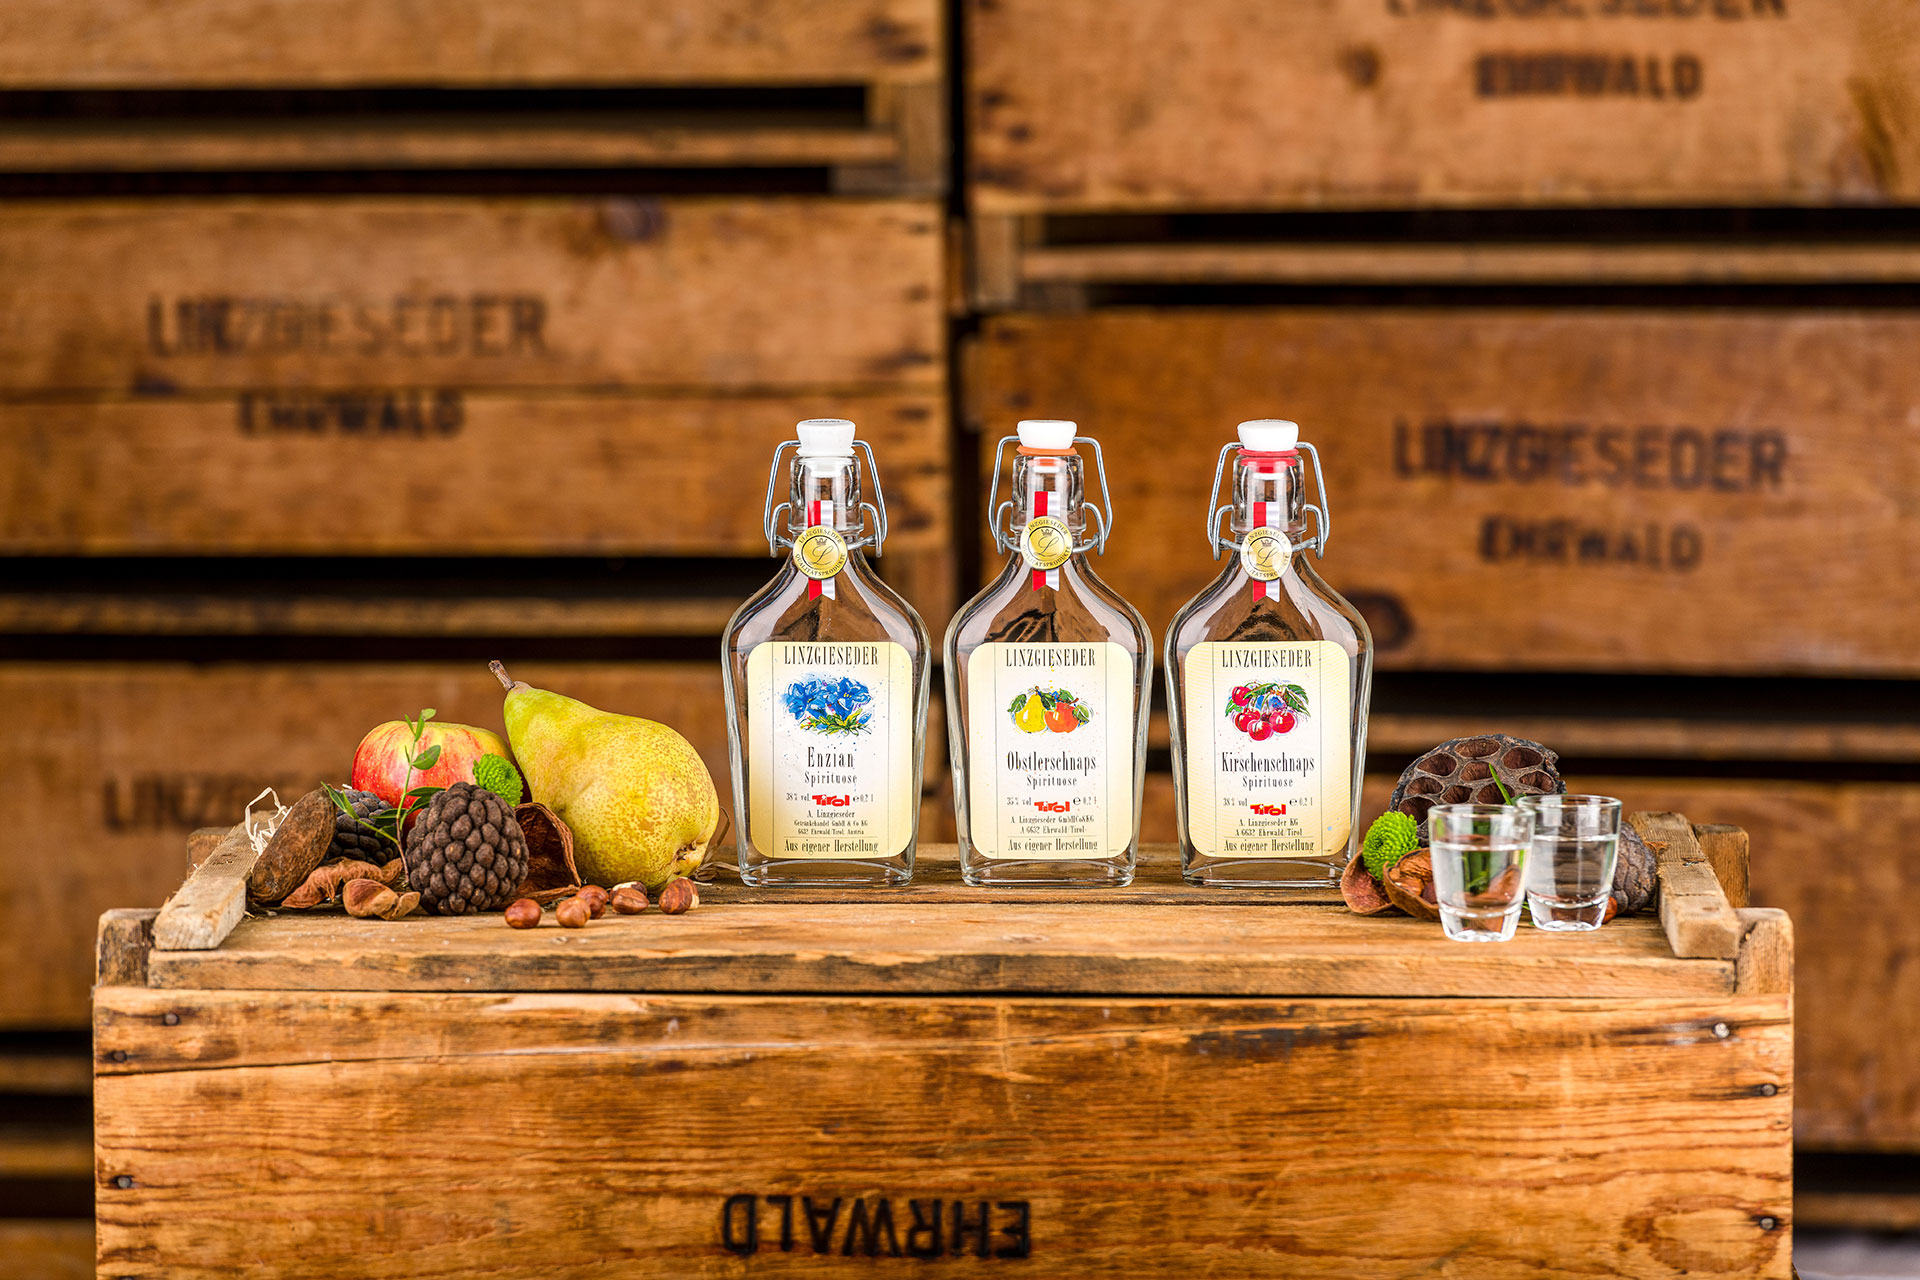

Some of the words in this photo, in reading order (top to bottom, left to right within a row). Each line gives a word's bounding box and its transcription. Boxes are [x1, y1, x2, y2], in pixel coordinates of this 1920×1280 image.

[1393, 418, 1789, 493] LINZGIESEDER
[1478, 514, 1704, 572] EHRWALD
[784, 645, 879, 665] LINZGIESEDER
[1006, 648, 1096, 667] LINZGIESEDER
[1222, 649, 1312, 668] LINZGIESEDER
[807, 746, 854, 768] Enzian
[1007, 751, 1097, 776] Obstlerschnaps
[1222, 752, 1315, 777] Kirschenschnaps
[804, 771, 858, 787] Spirituose
[1026, 774, 1077, 790] Spirituose
[1242, 775, 1294, 791] Spirituose
[816, 809, 855, 820] Linzgieseder
[1019, 815, 1056, 826] Linzgieseder
[1248, 818, 1287, 828] Linzgieseder
[784, 839, 799, 852] Aus
[801, 838, 831, 856] eigener
[834, 839, 879, 855] Herstellung
[1007, 839, 1022, 851] Aus
[1024, 838, 1052, 855] eigener
[1055, 838, 1098, 854] Herstellung
[1223, 839, 1238, 852] Aus
[1240, 839, 1268, 856] eigener
[1271, 839, 1314, 855] Herstellung
[722, 1193, 1031, 1260] EHRWALD
